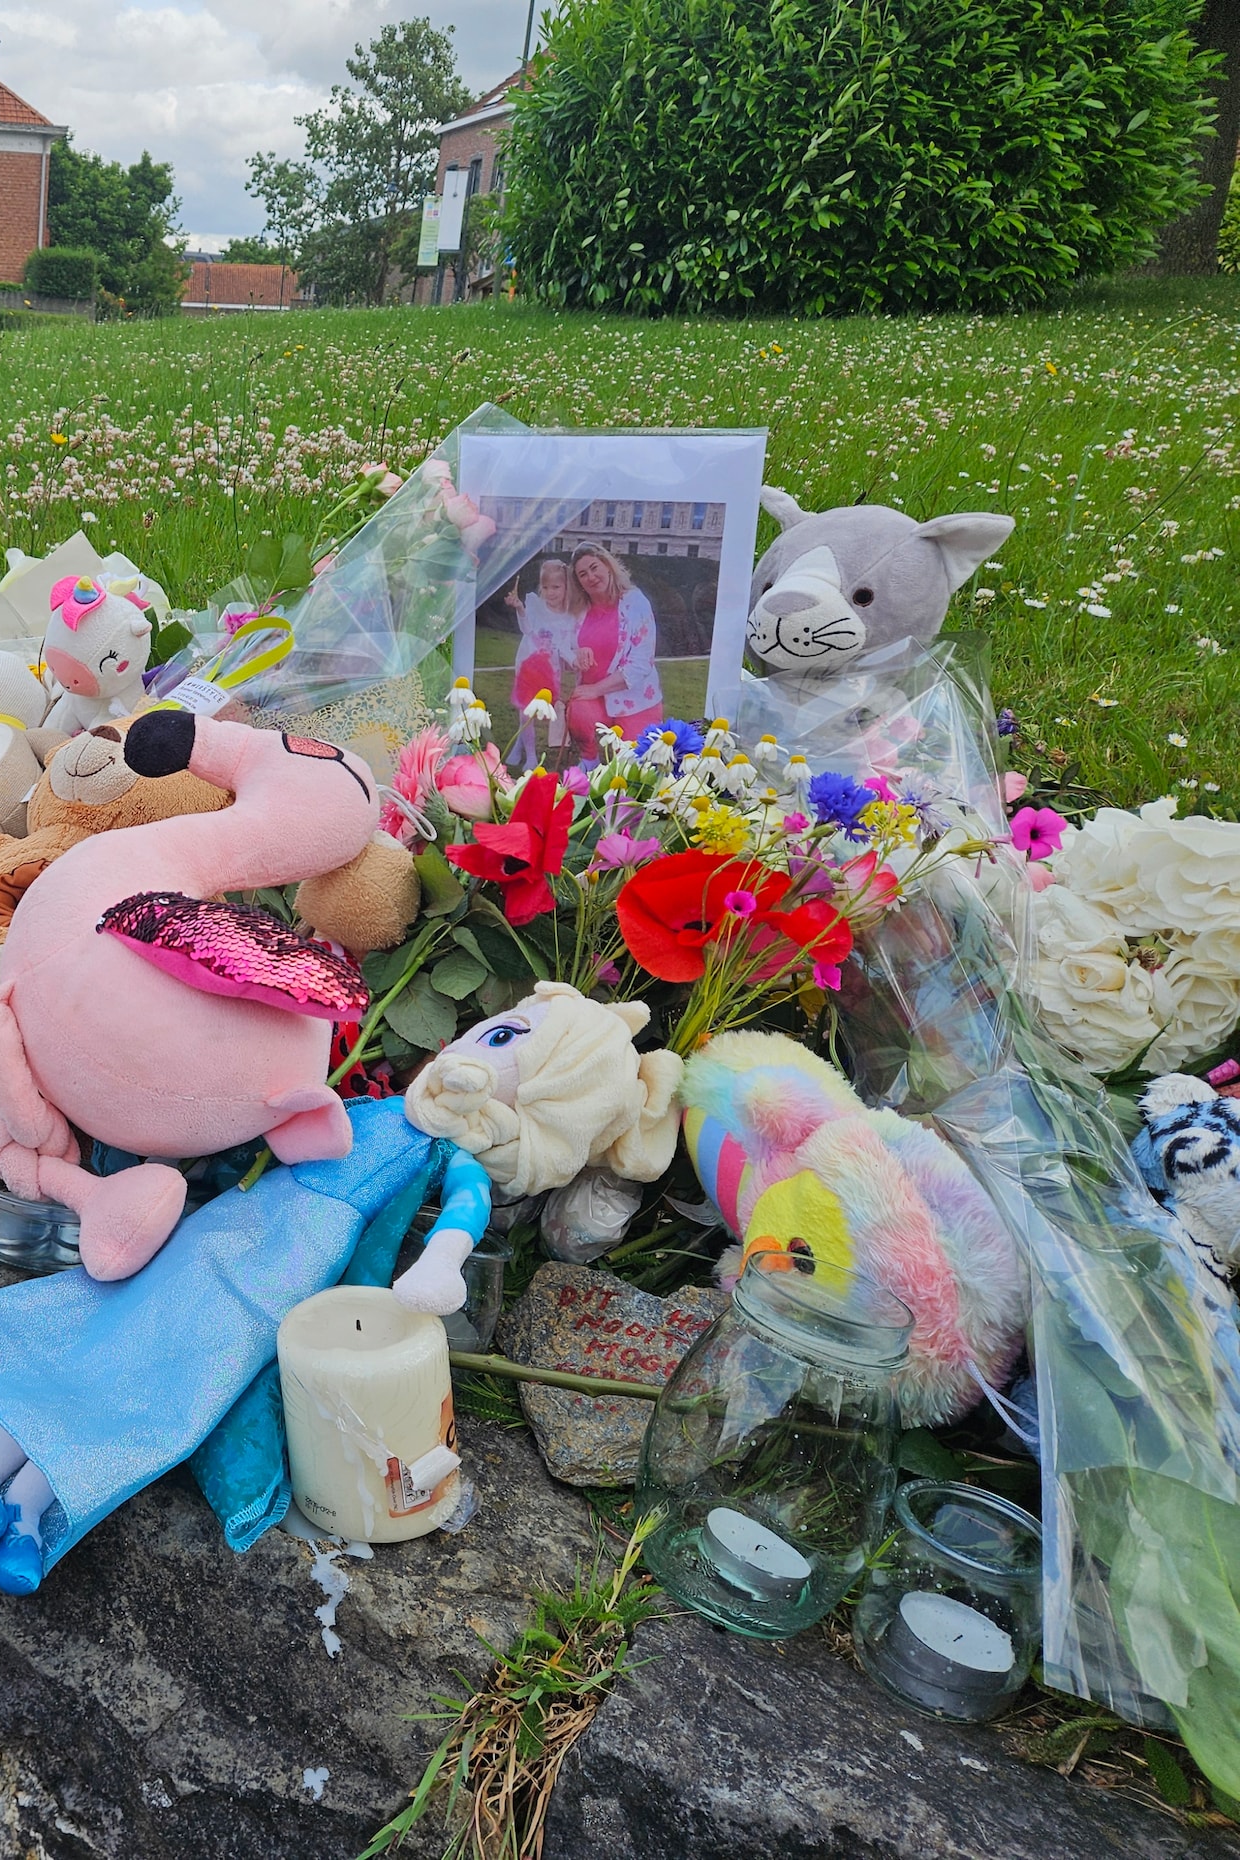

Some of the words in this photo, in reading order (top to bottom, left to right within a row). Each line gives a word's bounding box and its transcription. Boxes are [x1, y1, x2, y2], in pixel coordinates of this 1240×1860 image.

[558, 1285, 622, 1311] DIT
[666, 1309, 713, 1335] HA
[574, 1313, 691, 1349] NOOIT
